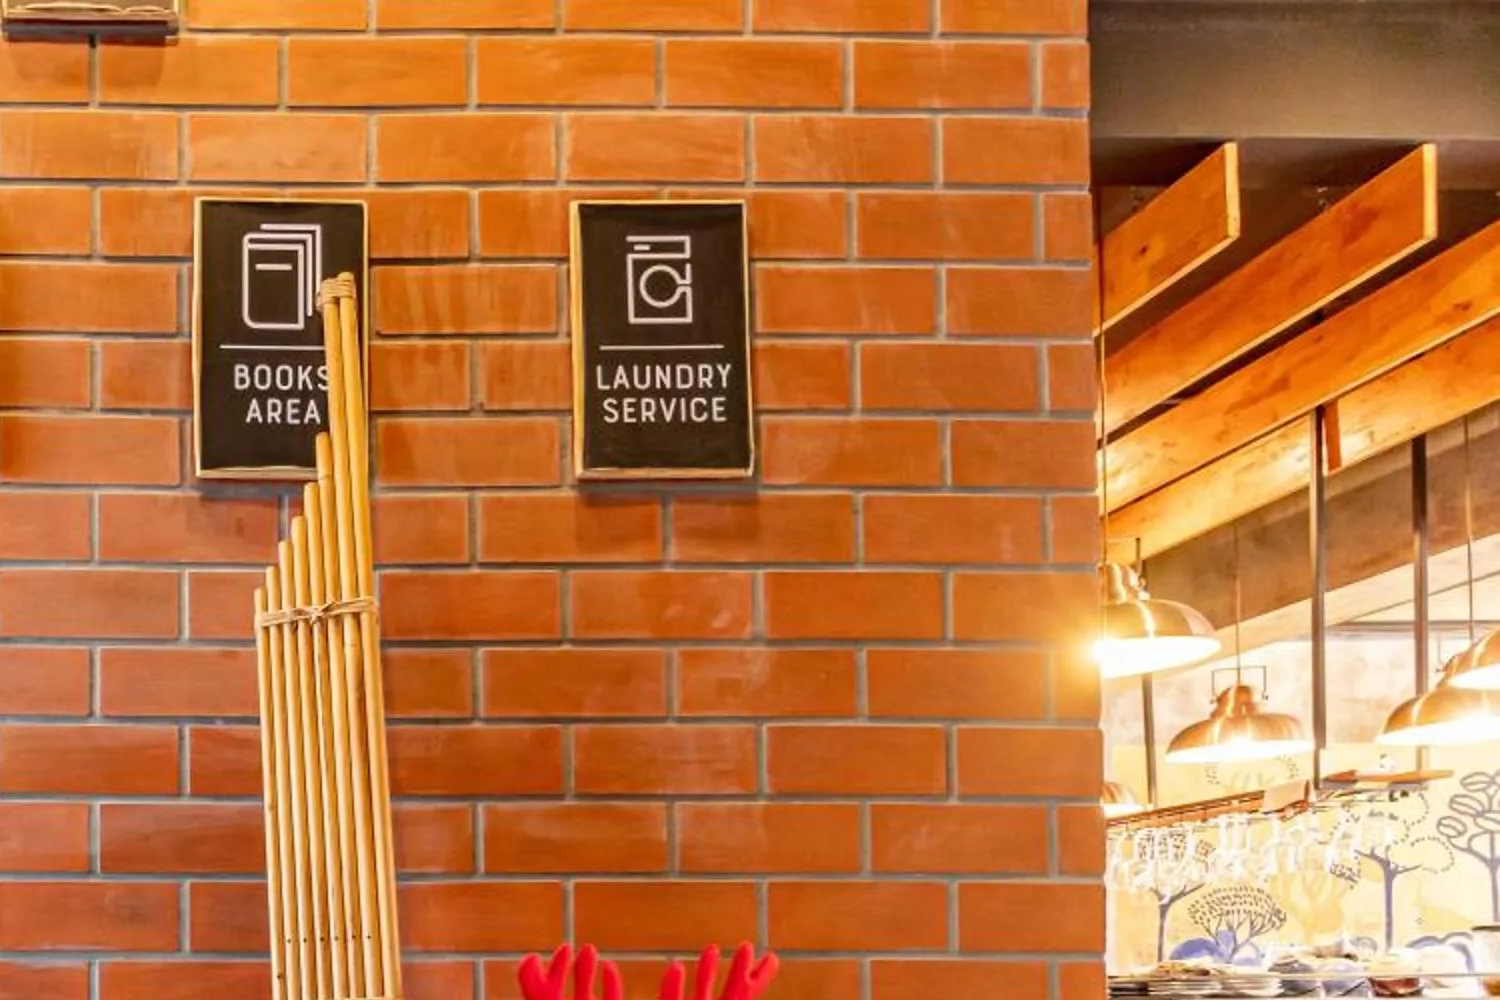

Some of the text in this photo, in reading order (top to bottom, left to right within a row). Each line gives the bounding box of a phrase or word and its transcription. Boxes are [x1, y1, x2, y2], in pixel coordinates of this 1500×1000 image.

[234, 363, 328, 391] BOOKS
[596, 363, 731, 390] LAUNDRY
[245, 397, 321, 425] AREA
[602, 396, 727, 423] SERVICE
